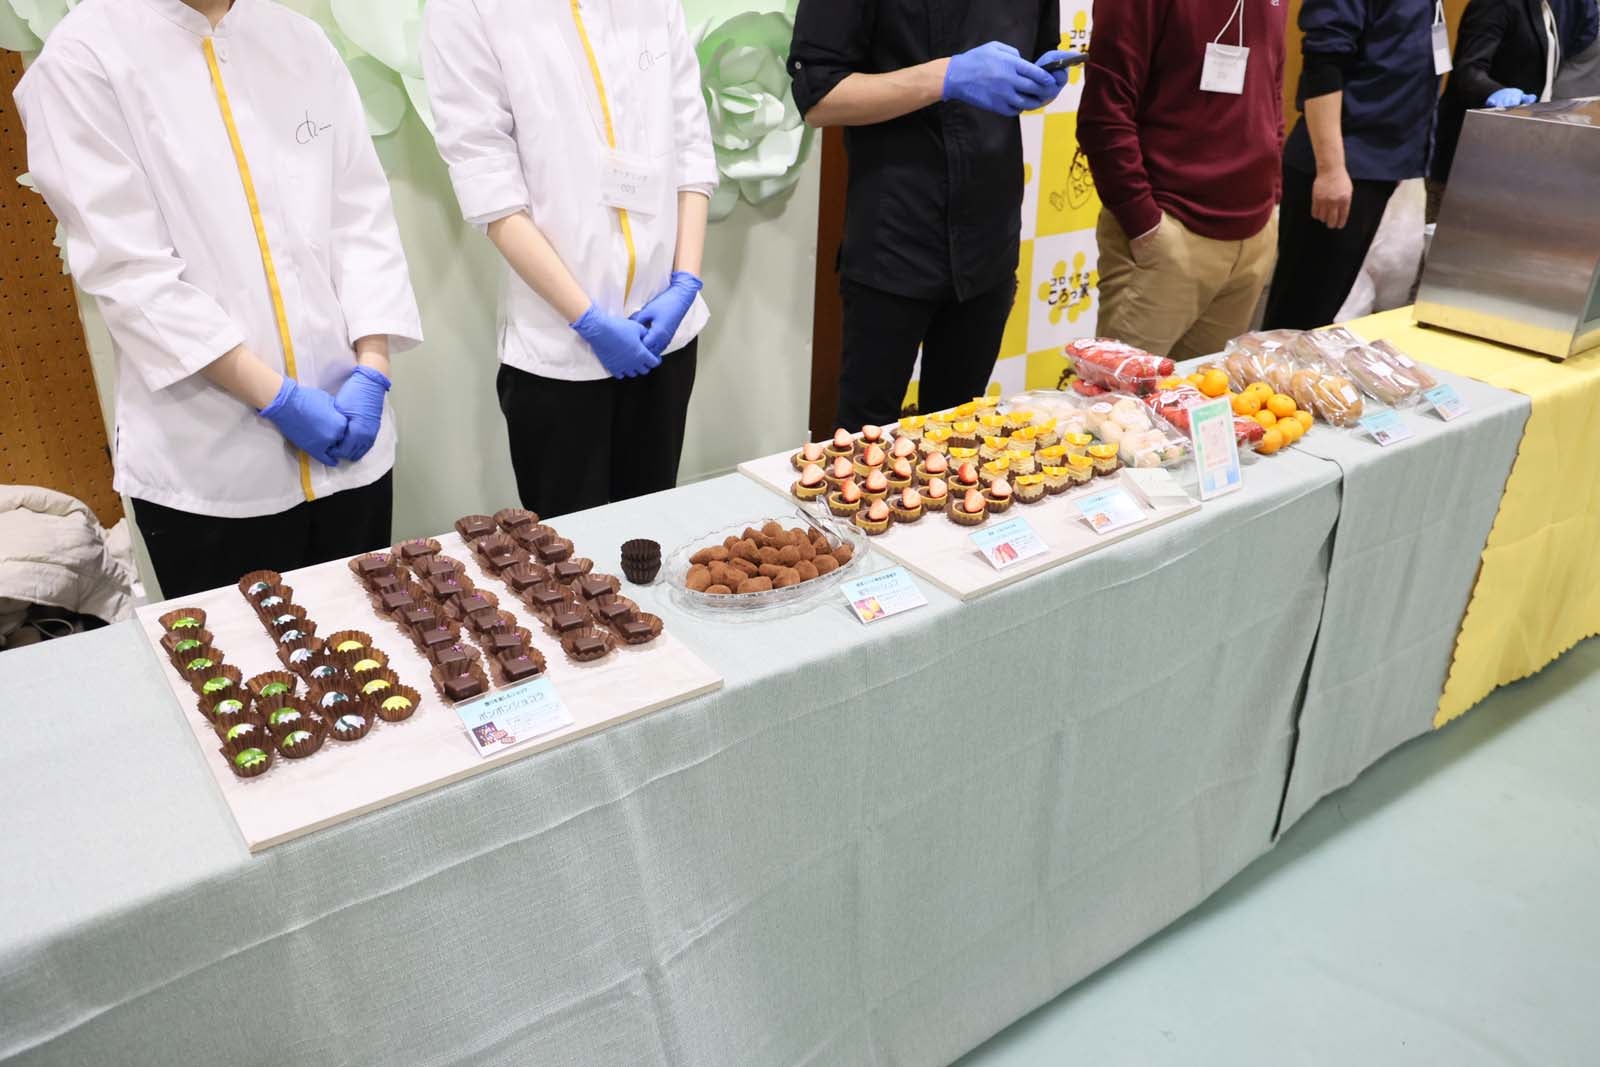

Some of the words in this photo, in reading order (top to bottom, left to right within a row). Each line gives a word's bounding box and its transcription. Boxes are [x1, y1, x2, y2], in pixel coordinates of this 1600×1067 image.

[1069, 30, 1091, 39] コロ
[1047, 272, 1090, 287] コロッケの
[1048, 281, 1090, 305] ころっ家
[479, 692, 544, 721] ボンボンショコラ
